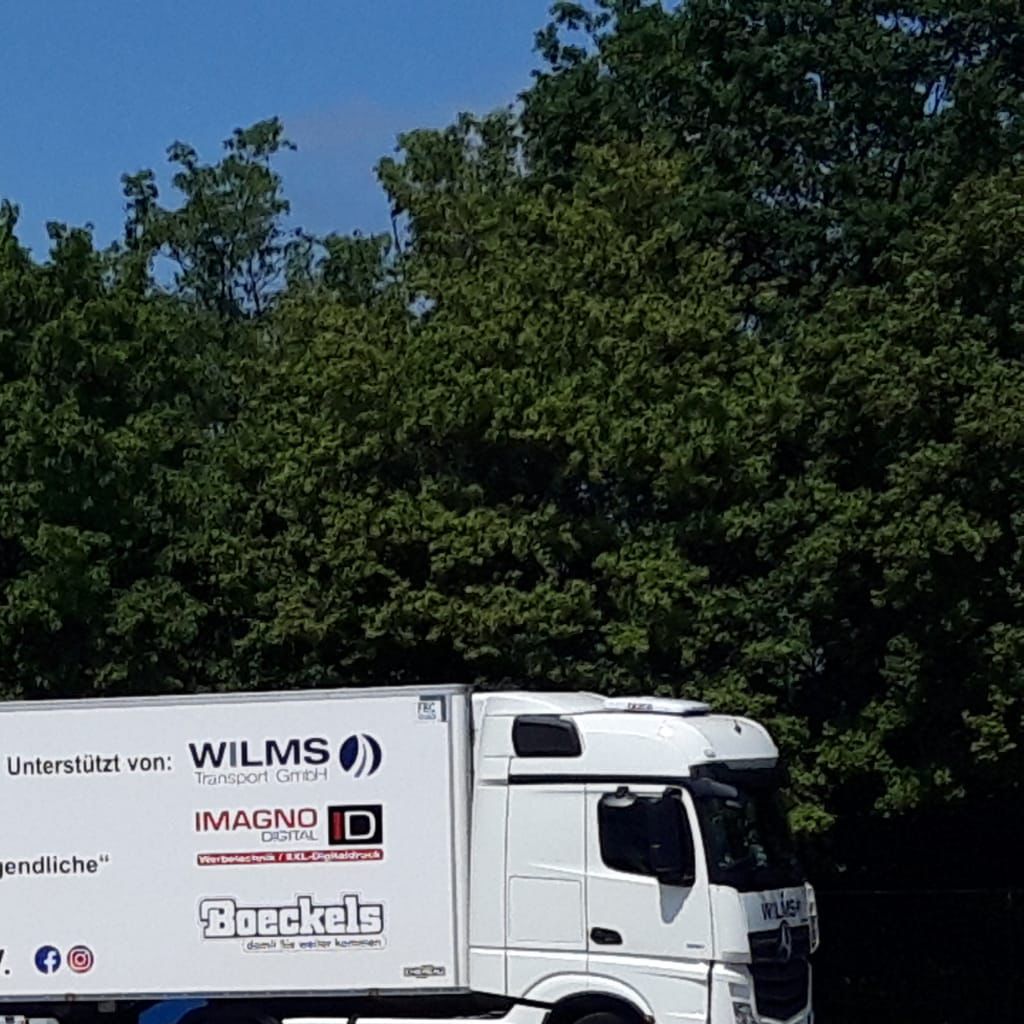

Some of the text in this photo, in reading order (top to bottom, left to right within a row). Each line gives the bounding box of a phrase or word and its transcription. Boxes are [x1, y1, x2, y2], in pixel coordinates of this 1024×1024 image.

[188, 736, 331, 769] WILMS
[7, 754, 173, 776] Unterstützt von:
[194, 767, 328, 786] Transport GmbH
[195, 807, 319, 832] IMAGNO
[261, 830, 319, 843] DIGITAL
[199, 894, 384, 939] Boeckels
